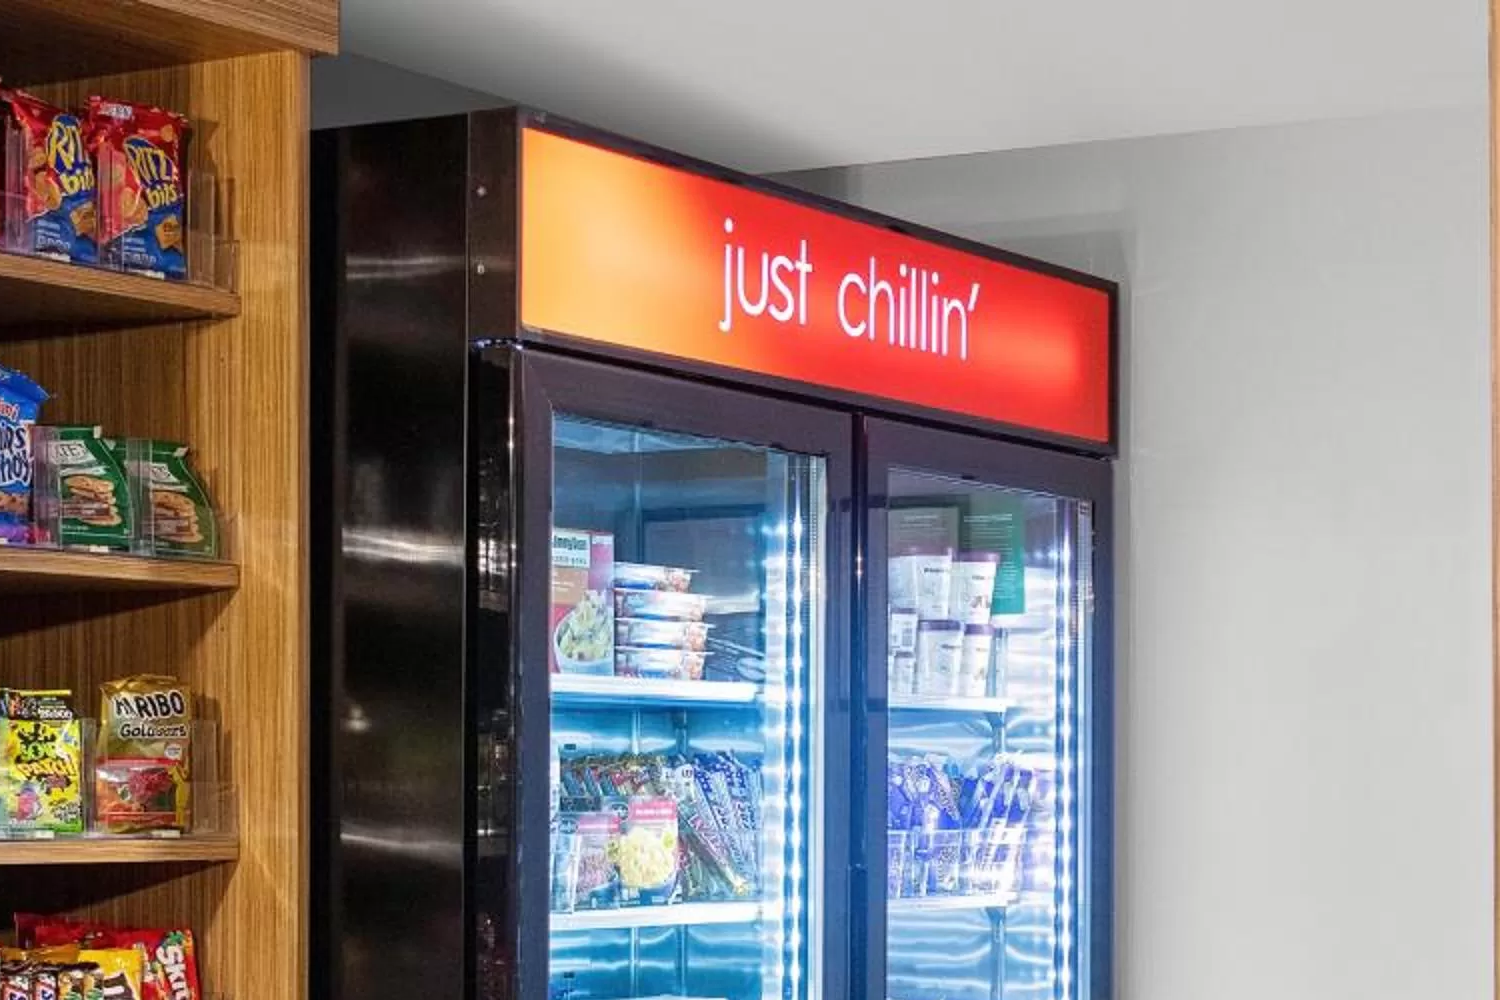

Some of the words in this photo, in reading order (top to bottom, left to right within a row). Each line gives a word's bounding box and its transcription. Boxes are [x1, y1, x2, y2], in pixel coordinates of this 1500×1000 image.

[718, 217, 814, 333] just
[837, 255, 981, 361] chillin'
[113, 691, 187, 720] HARIBO
